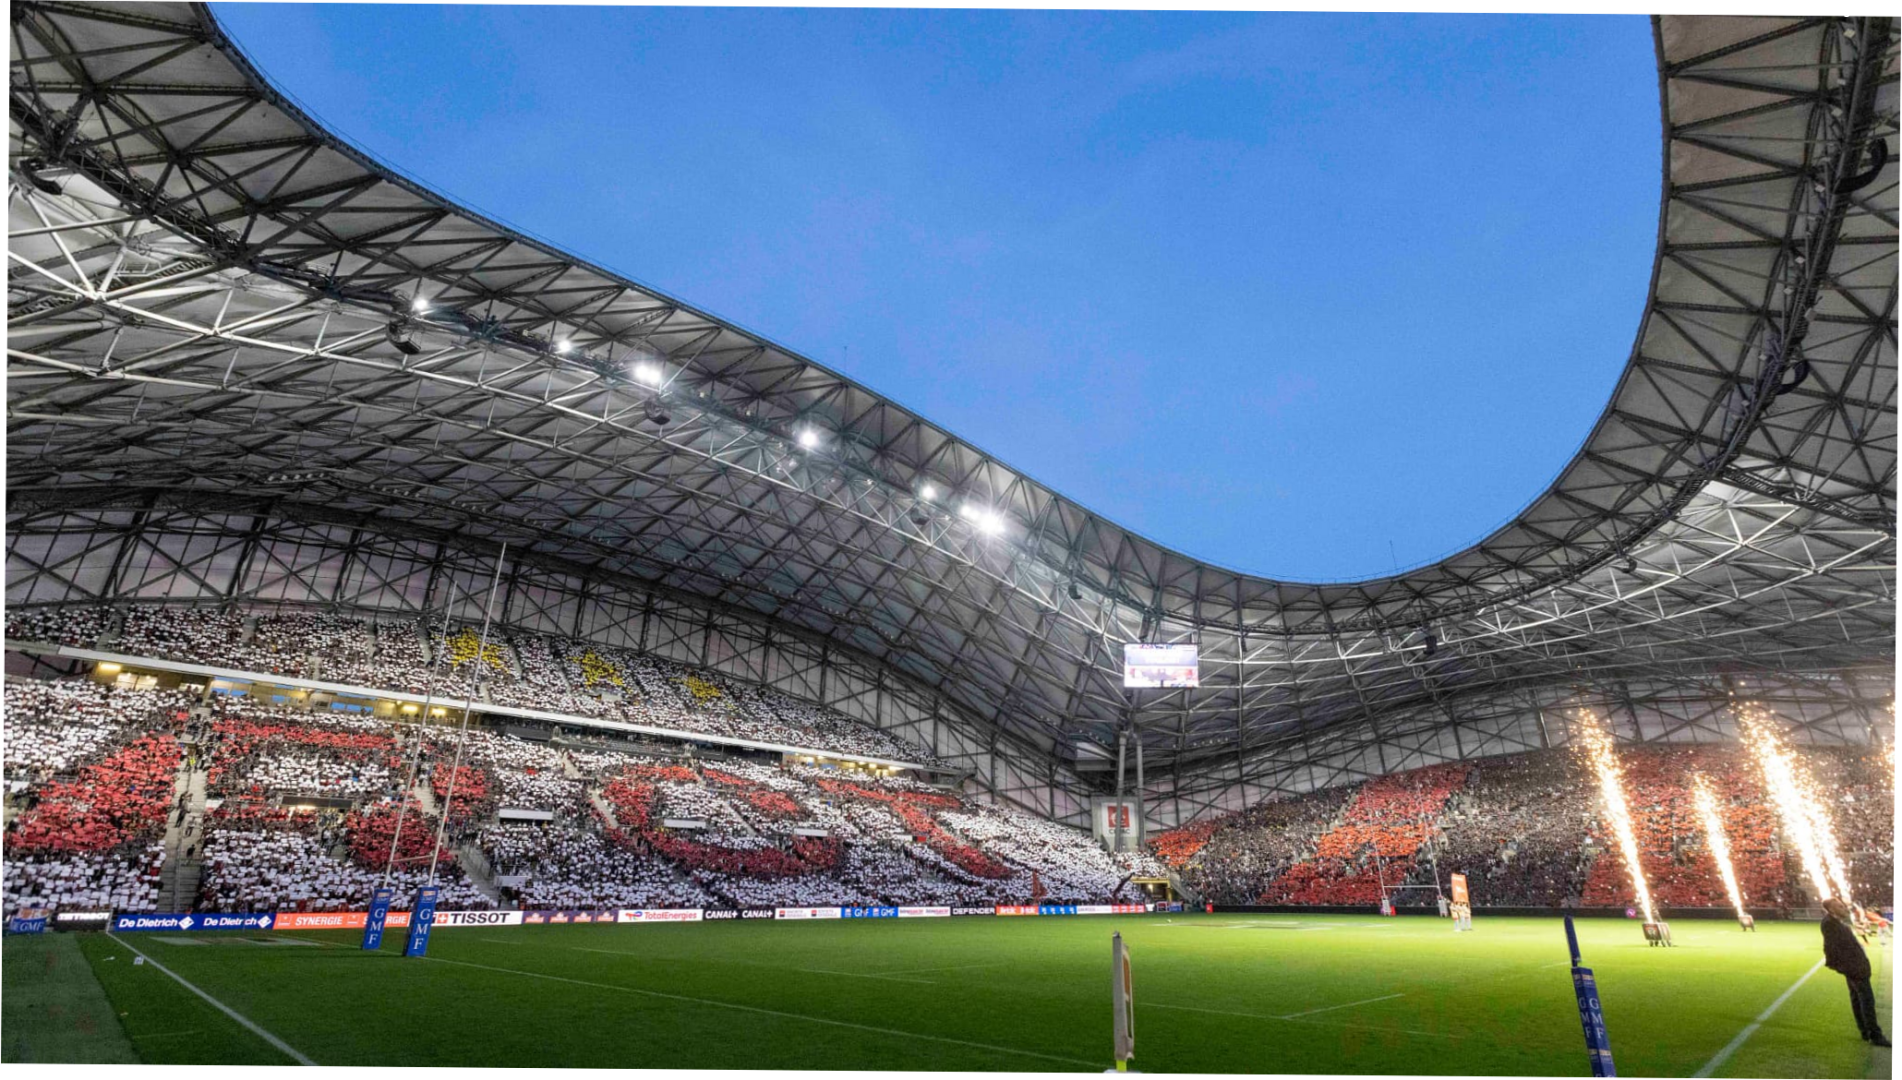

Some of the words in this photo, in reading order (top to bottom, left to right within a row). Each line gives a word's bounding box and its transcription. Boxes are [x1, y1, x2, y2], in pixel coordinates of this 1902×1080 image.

[645, 911, 697, 921] TotalEnergies
[705, 909, 738, 919] CANAL+
[742, 909, 773, 918] CANAL+
[880, 908, 895, 916] GMF
[952, 907, 995, 915] DEFENDER
[118, 918, 134, 928] De
[136, 916, 178, 927] Dietrich
[203, 917, 218, 926] De
[219, 916, 257, 926] Dietrch
[295, 915, 344, 926] SYNERGIE
[363, 915, 407, 925] SRGIE
[452, 913, 510, 924] TISSOT
[20, 921, 44, 932] GMF
[368, 908, 385, 945] GMF
[413, 908, 431, 950] GMF
